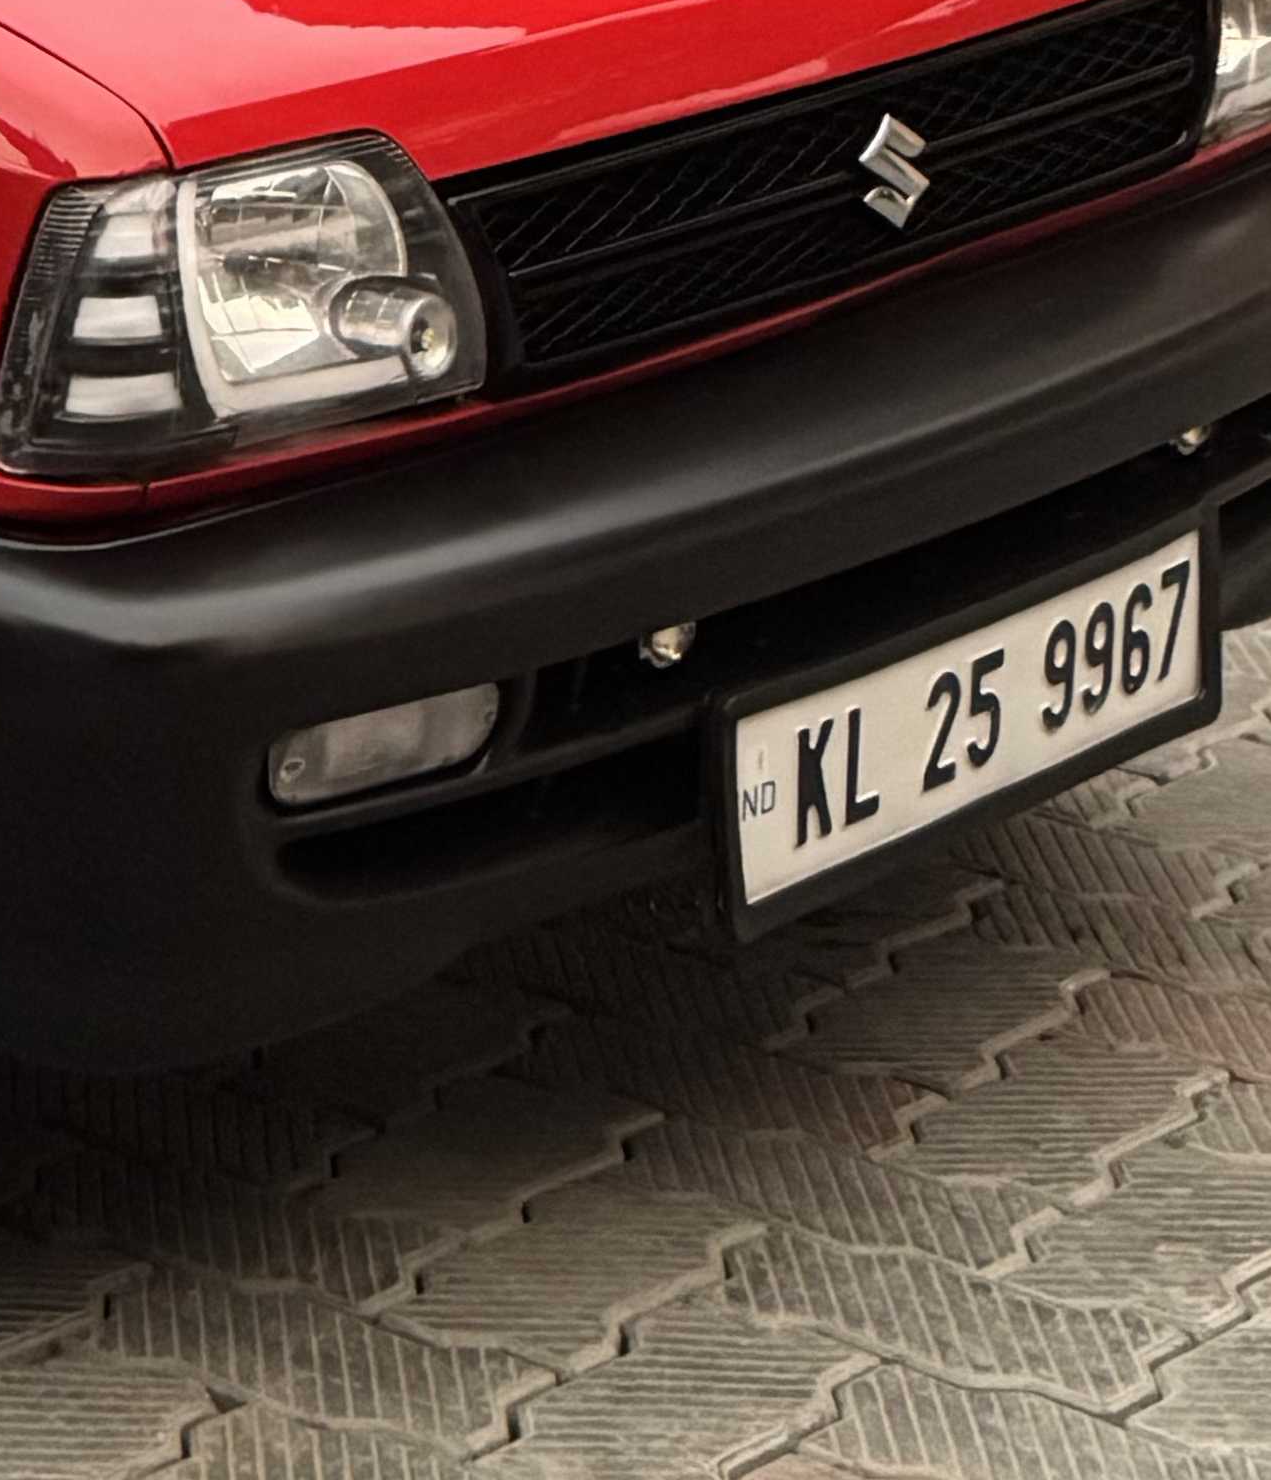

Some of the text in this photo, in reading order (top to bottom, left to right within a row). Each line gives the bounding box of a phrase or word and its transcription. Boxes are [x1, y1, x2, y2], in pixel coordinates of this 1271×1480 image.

[794, 559, 1191, 848] KL 25 9967
